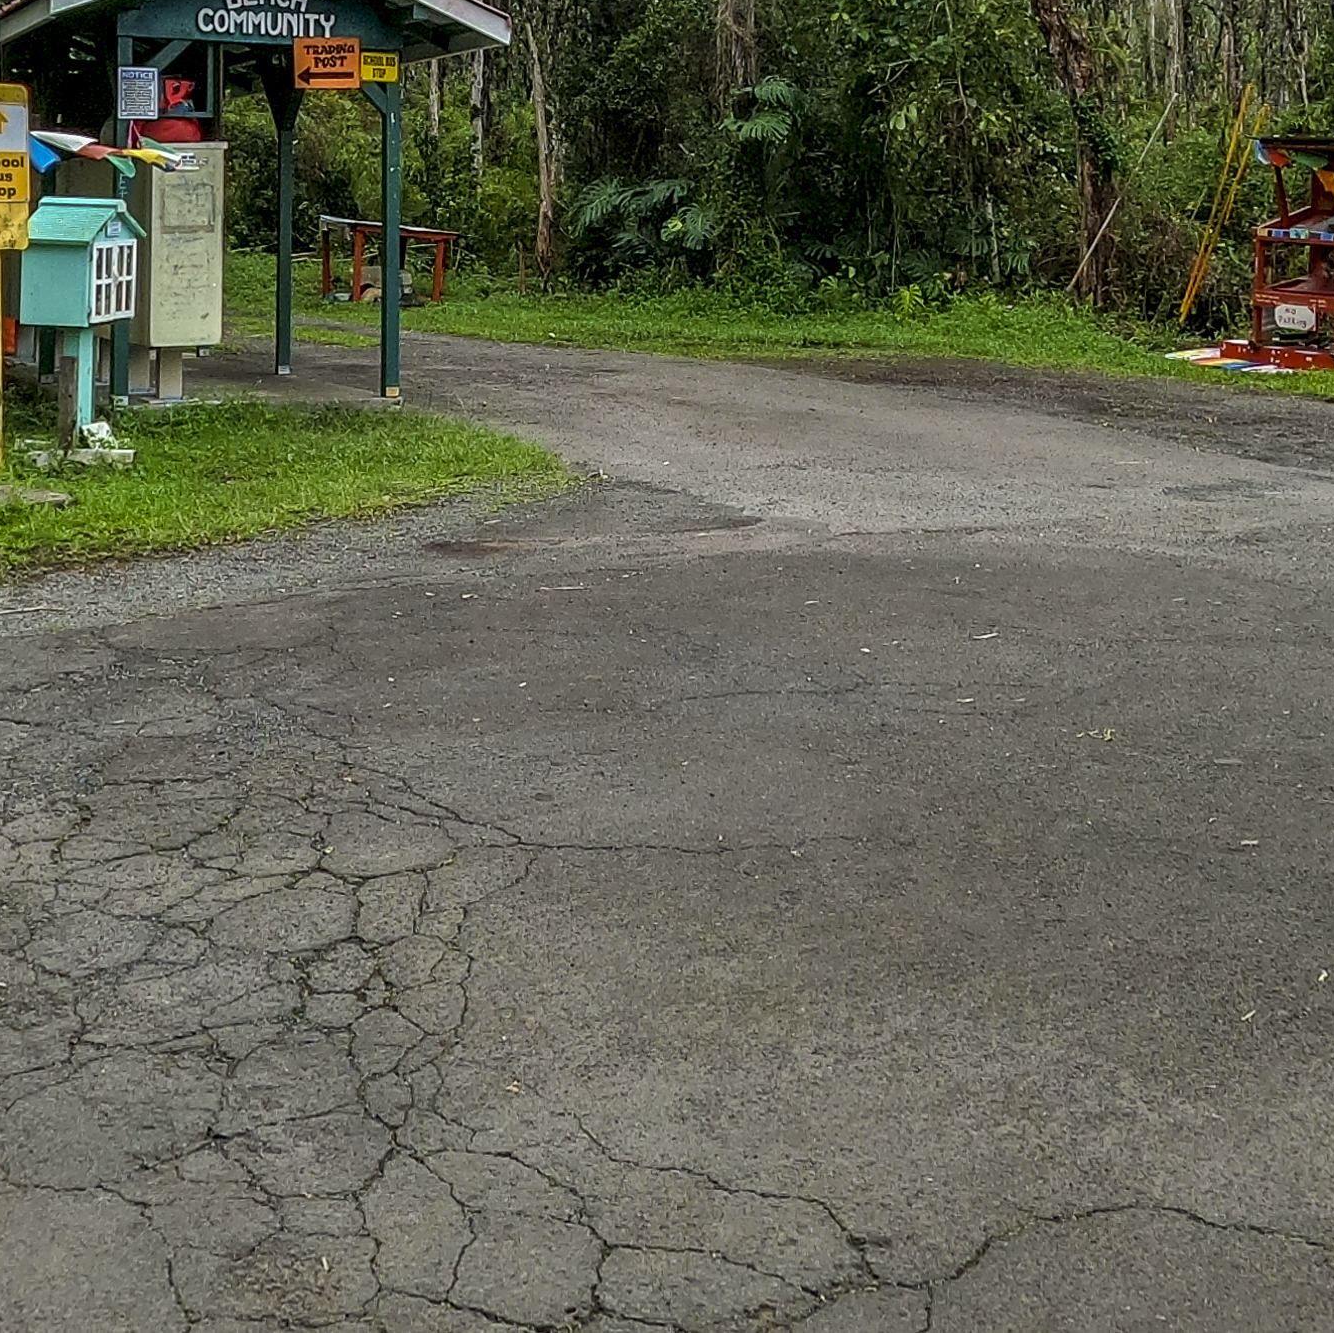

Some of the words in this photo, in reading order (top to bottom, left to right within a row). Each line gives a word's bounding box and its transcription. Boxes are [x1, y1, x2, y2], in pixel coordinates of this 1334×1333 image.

[197, 8, 336, 38] COMMUNITY
[313, 55, 348, 69] POST
[122, 71, 154, 80] NOTICE
